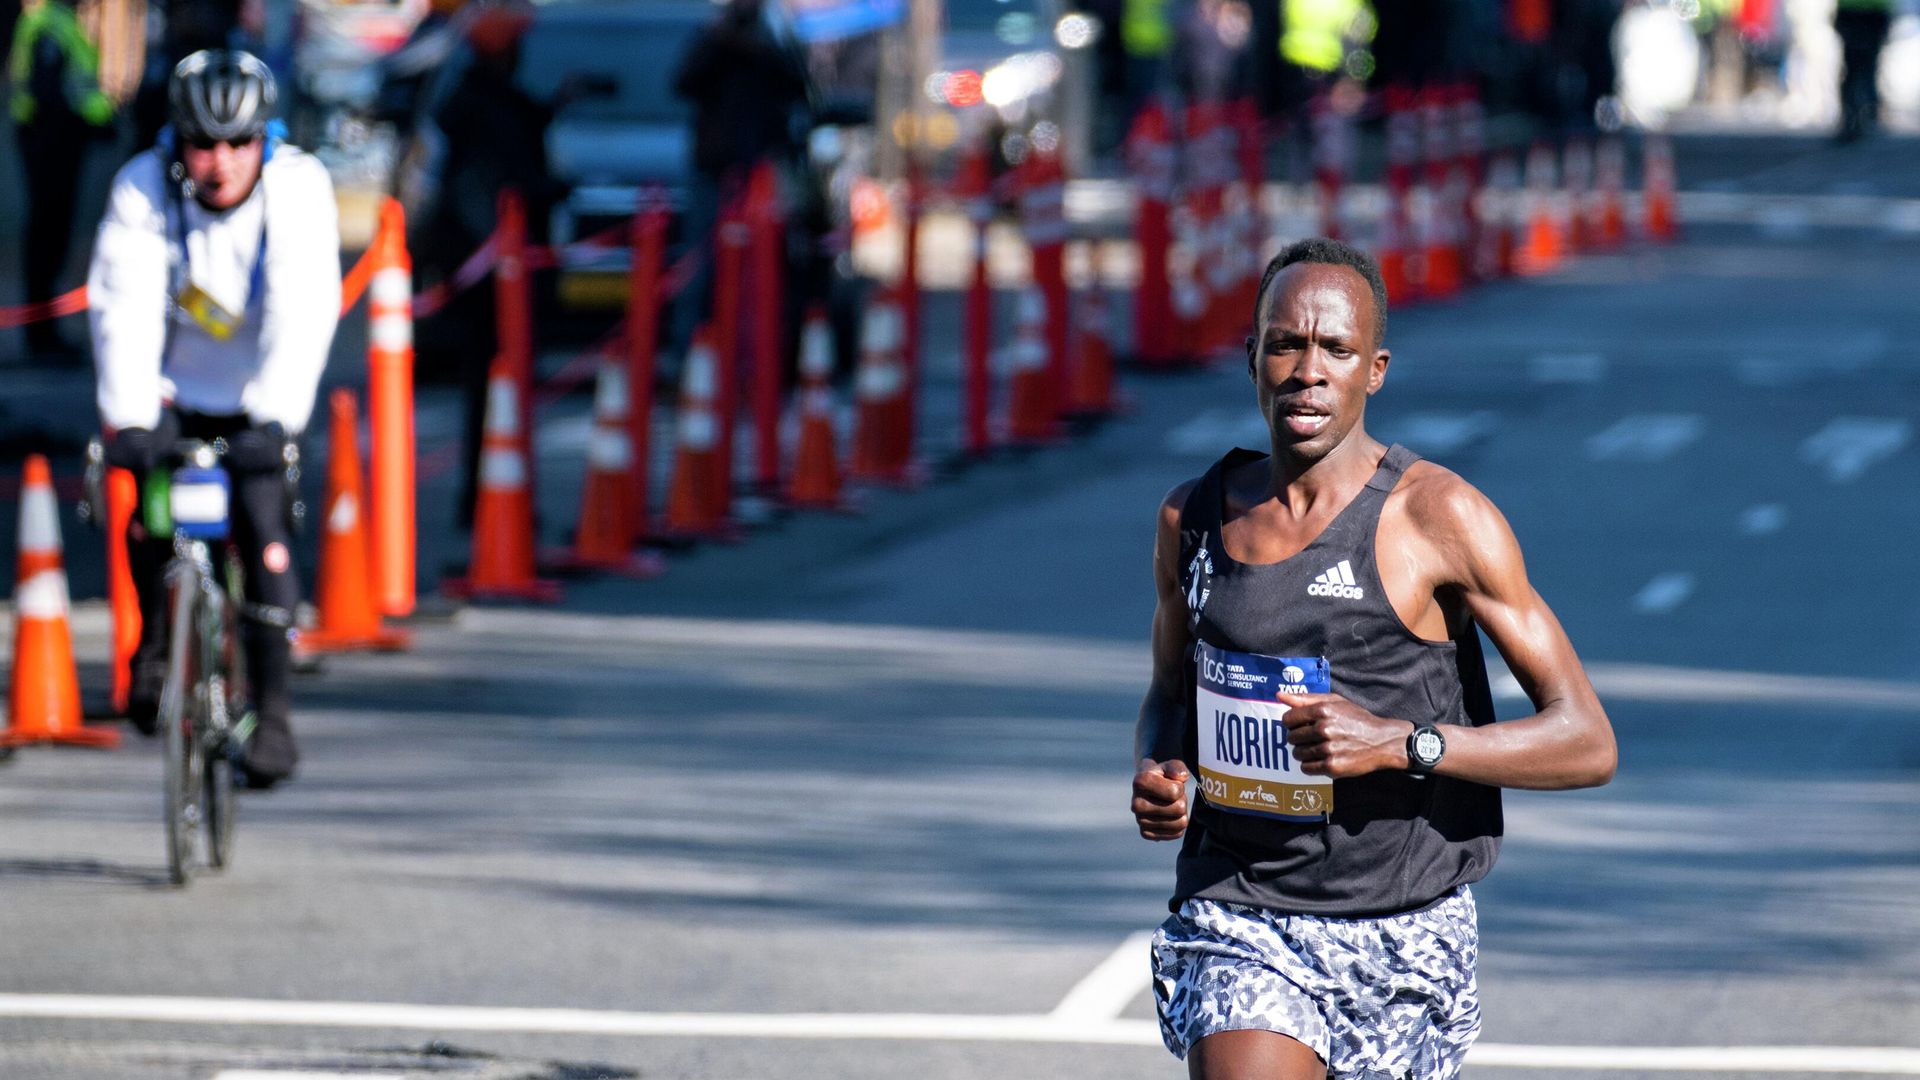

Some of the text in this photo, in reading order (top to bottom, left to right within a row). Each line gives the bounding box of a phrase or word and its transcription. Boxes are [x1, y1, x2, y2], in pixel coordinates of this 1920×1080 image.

[1307, 581, 1364, 600] adidas
[1203, 650, 1226, 685] tcs
[1226, 664, 1245, 673] TATA
[1226, 672, 1268, 684] CONSULTANCY
[1227, 680, 1253, 690] SERVICES
[1278, 684, 1309, 694] TATA
[1215, 709, 1290, 772] KORIR
[1200, 774, 1228, 799] 2021
